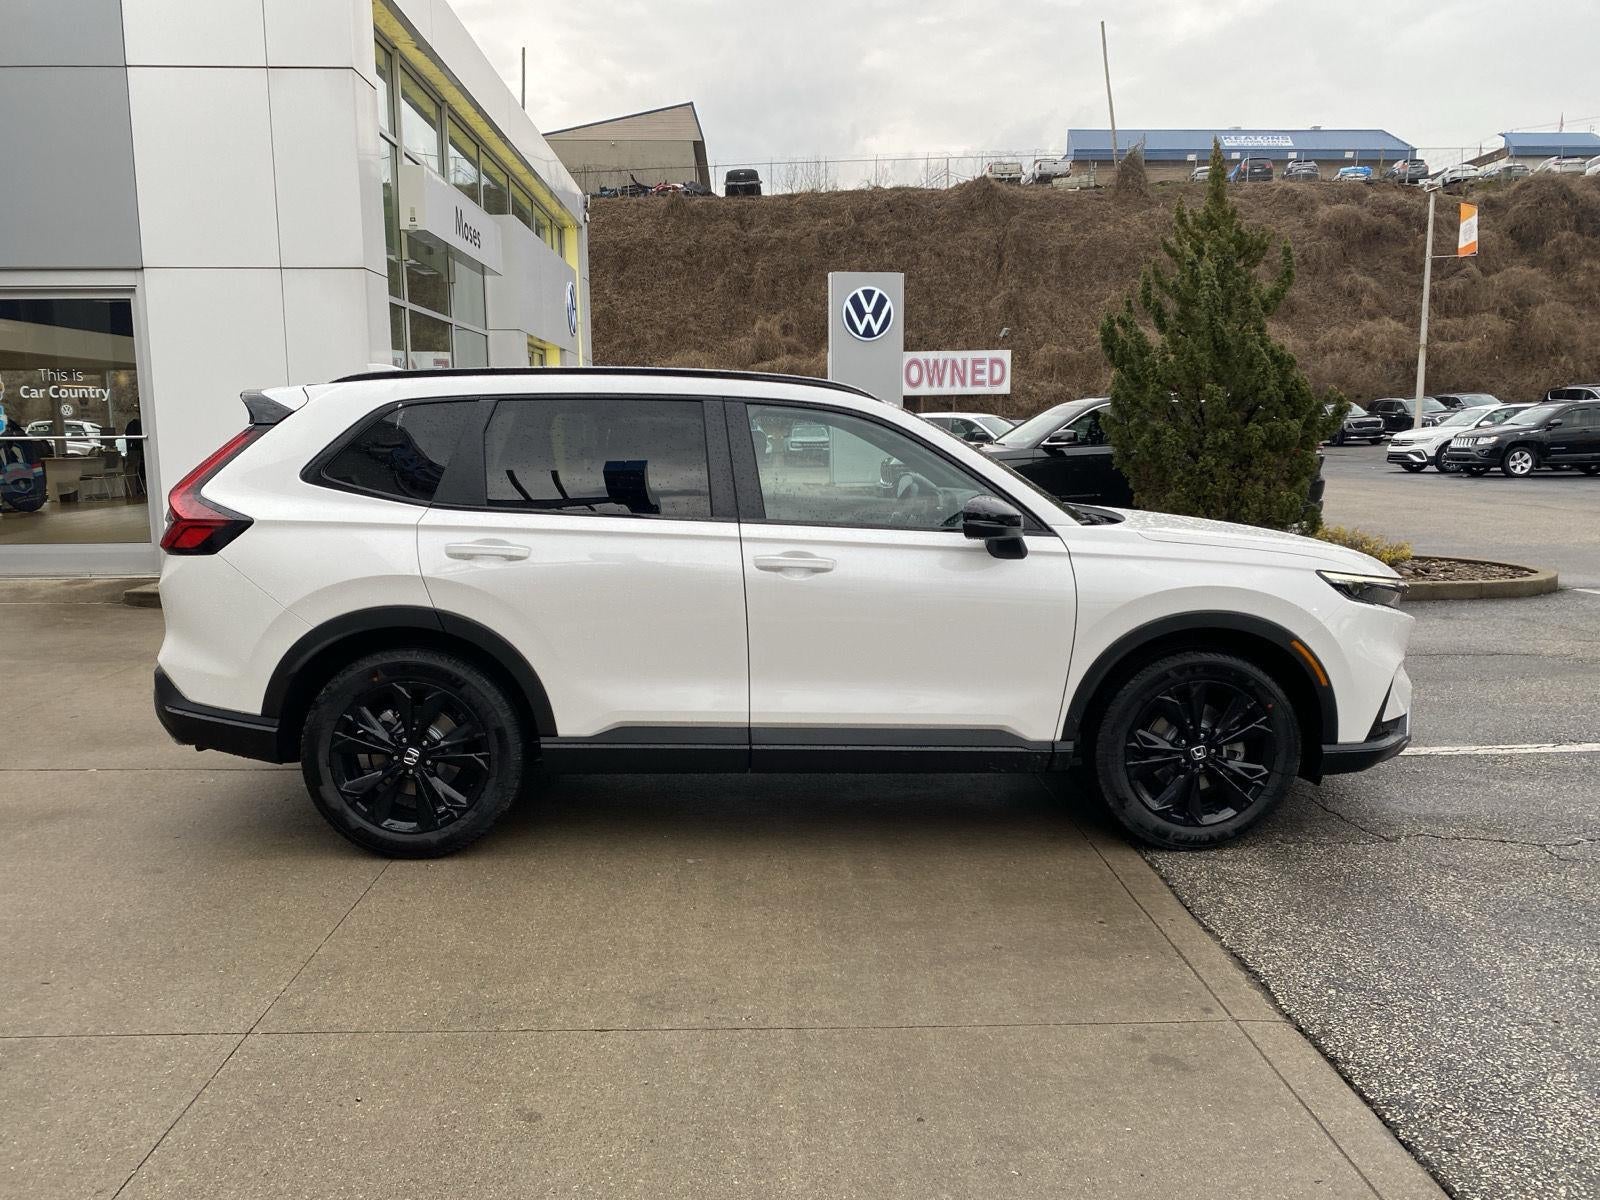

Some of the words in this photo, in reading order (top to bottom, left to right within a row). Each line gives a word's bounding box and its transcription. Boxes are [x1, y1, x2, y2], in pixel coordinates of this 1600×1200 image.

[455, 206, 481, 249] Moses
[38, 369, 67, 382] This
[72, 369, 84, 381] is
[904, 357, 1007, 389] OWNED
[20, 386, 45, 399] Car
[49, 386, 111, 402] Country
